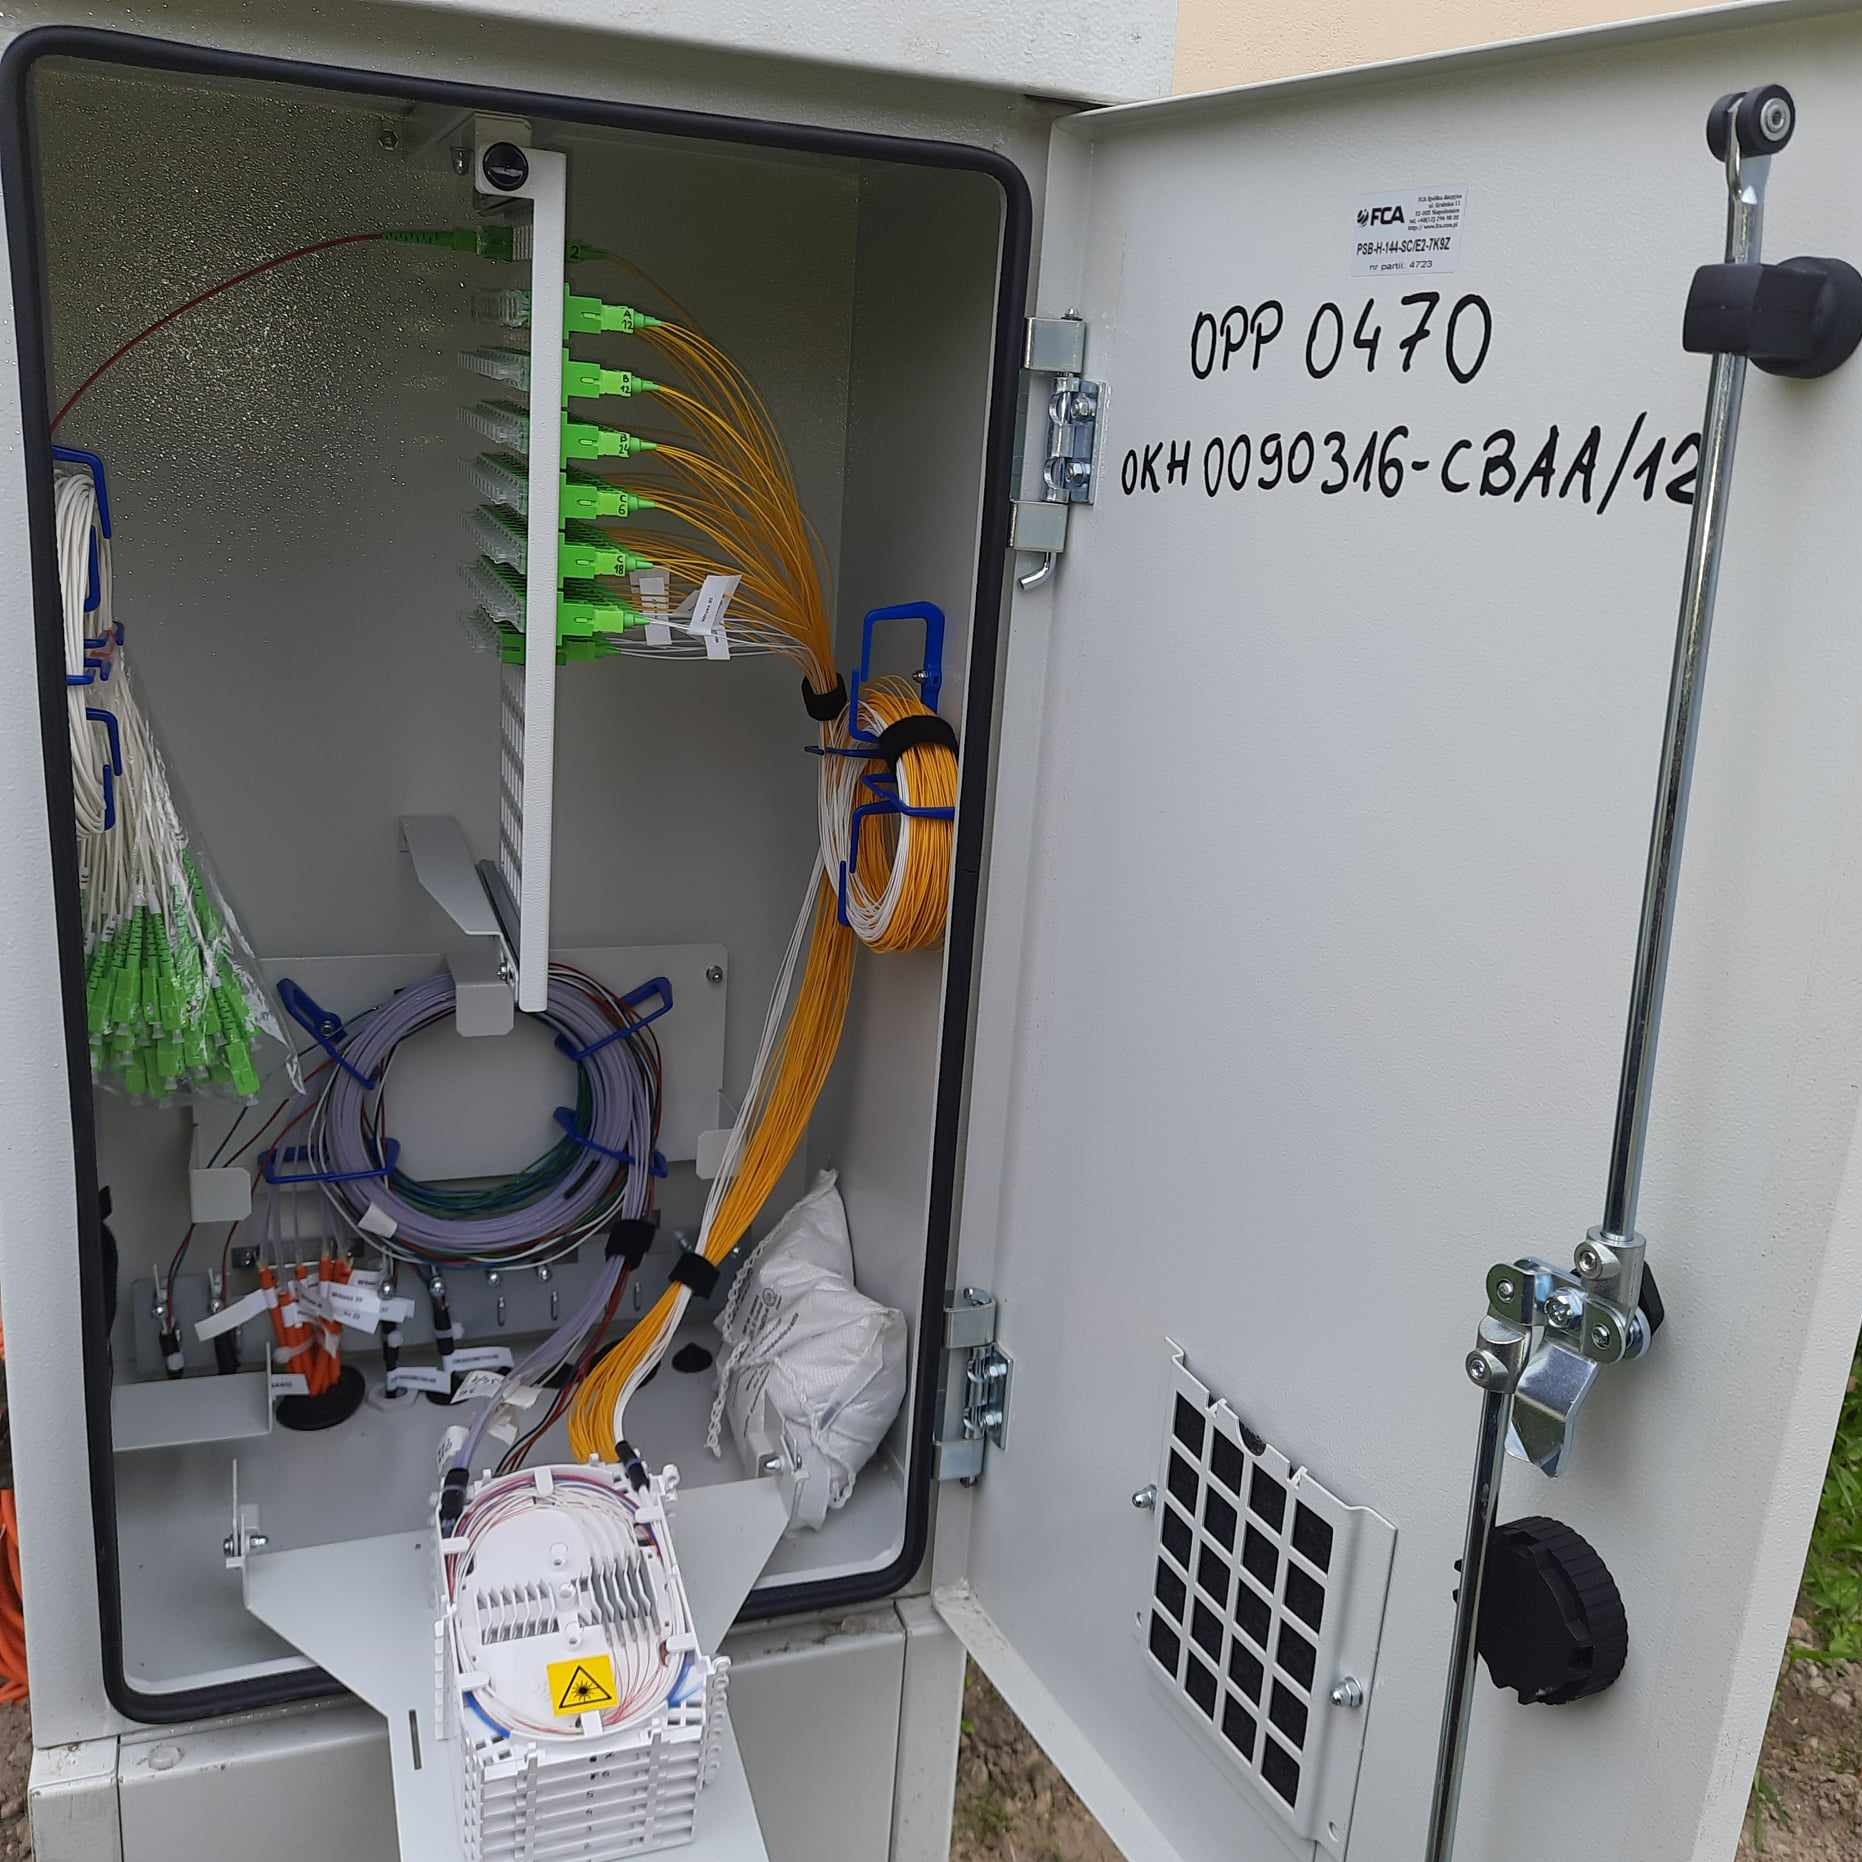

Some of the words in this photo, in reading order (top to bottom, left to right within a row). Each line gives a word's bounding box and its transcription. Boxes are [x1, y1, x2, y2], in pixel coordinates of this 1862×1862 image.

[1370, 205, 1405, 226] FCA
[1409, 260, 1433, 269] 4723
[1190, 299, 1284, 380] OPP
[1305, 291, 1493, 385] 0470
